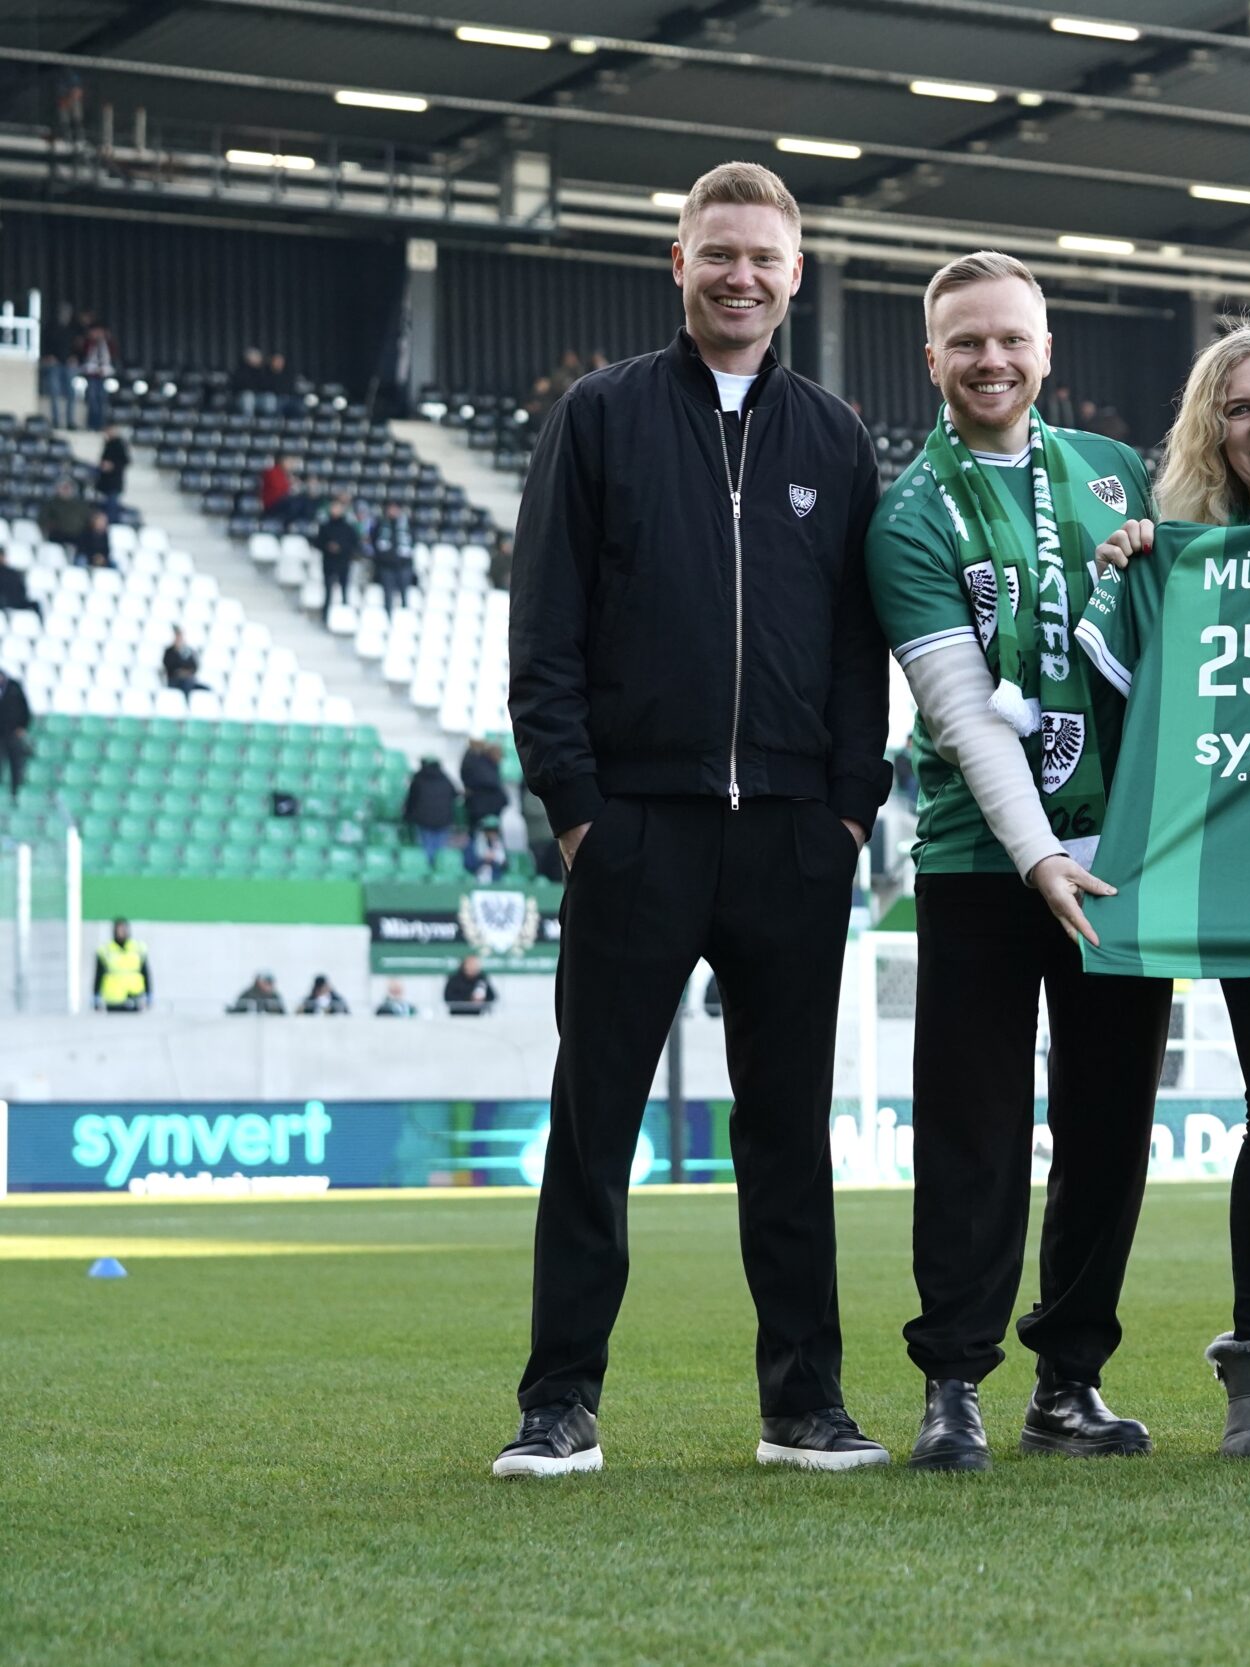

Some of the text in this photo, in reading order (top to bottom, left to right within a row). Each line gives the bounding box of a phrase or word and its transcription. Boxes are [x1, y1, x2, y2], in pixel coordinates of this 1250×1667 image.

[1042, 775, 1061, 785] 906
[1237, 771, 1247, 781] a
[1050, 803, 1095, 838] 06
[72, 1100, 332, 1187] synvert
